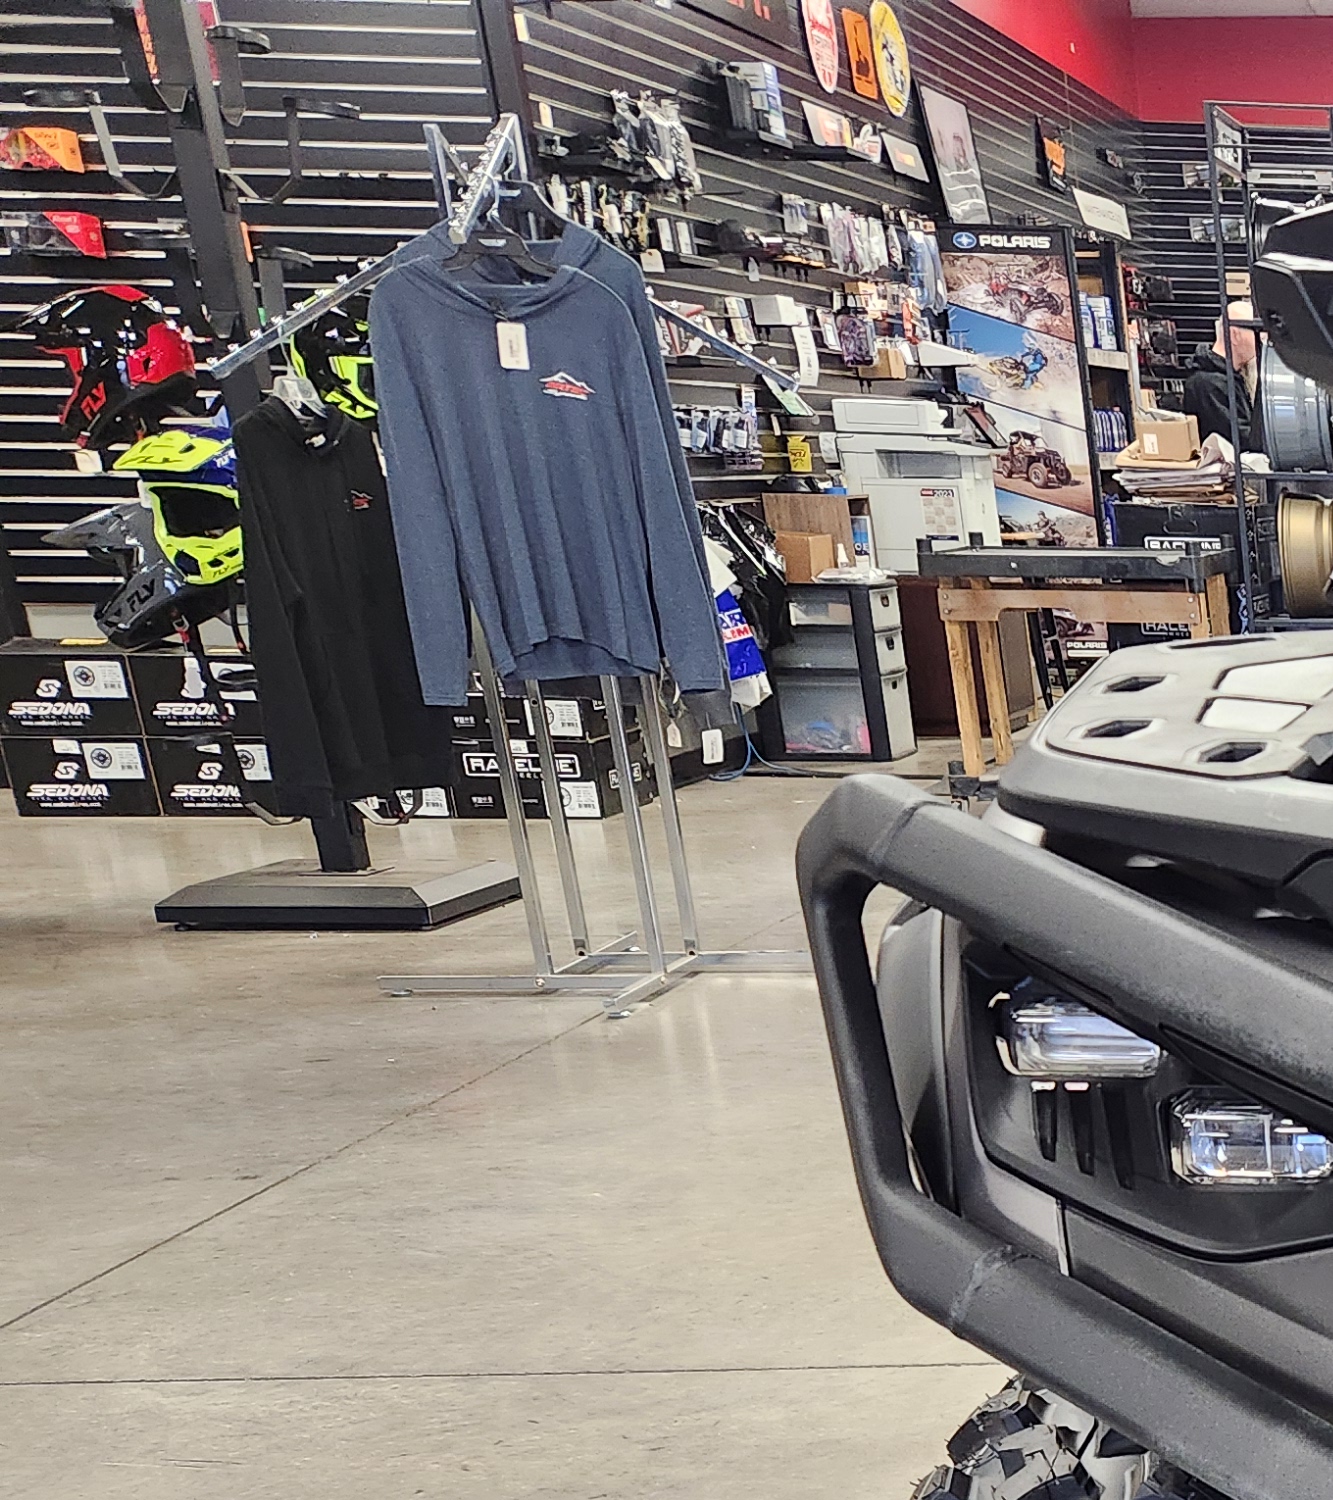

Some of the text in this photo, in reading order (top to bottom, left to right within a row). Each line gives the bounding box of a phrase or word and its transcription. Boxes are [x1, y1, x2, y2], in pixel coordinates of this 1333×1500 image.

[978, 235, 1051, 248] POLARIS
[81, 382, 107, 421] FLY
[934, 489, 954, 498] 2023
[127, 578, 155, 613] FLY
[1067, 642, 1107, 650] POLARIS
[8, 702, 92, 716] SEDONA
[26, 784, 110, 797] SEDONA
